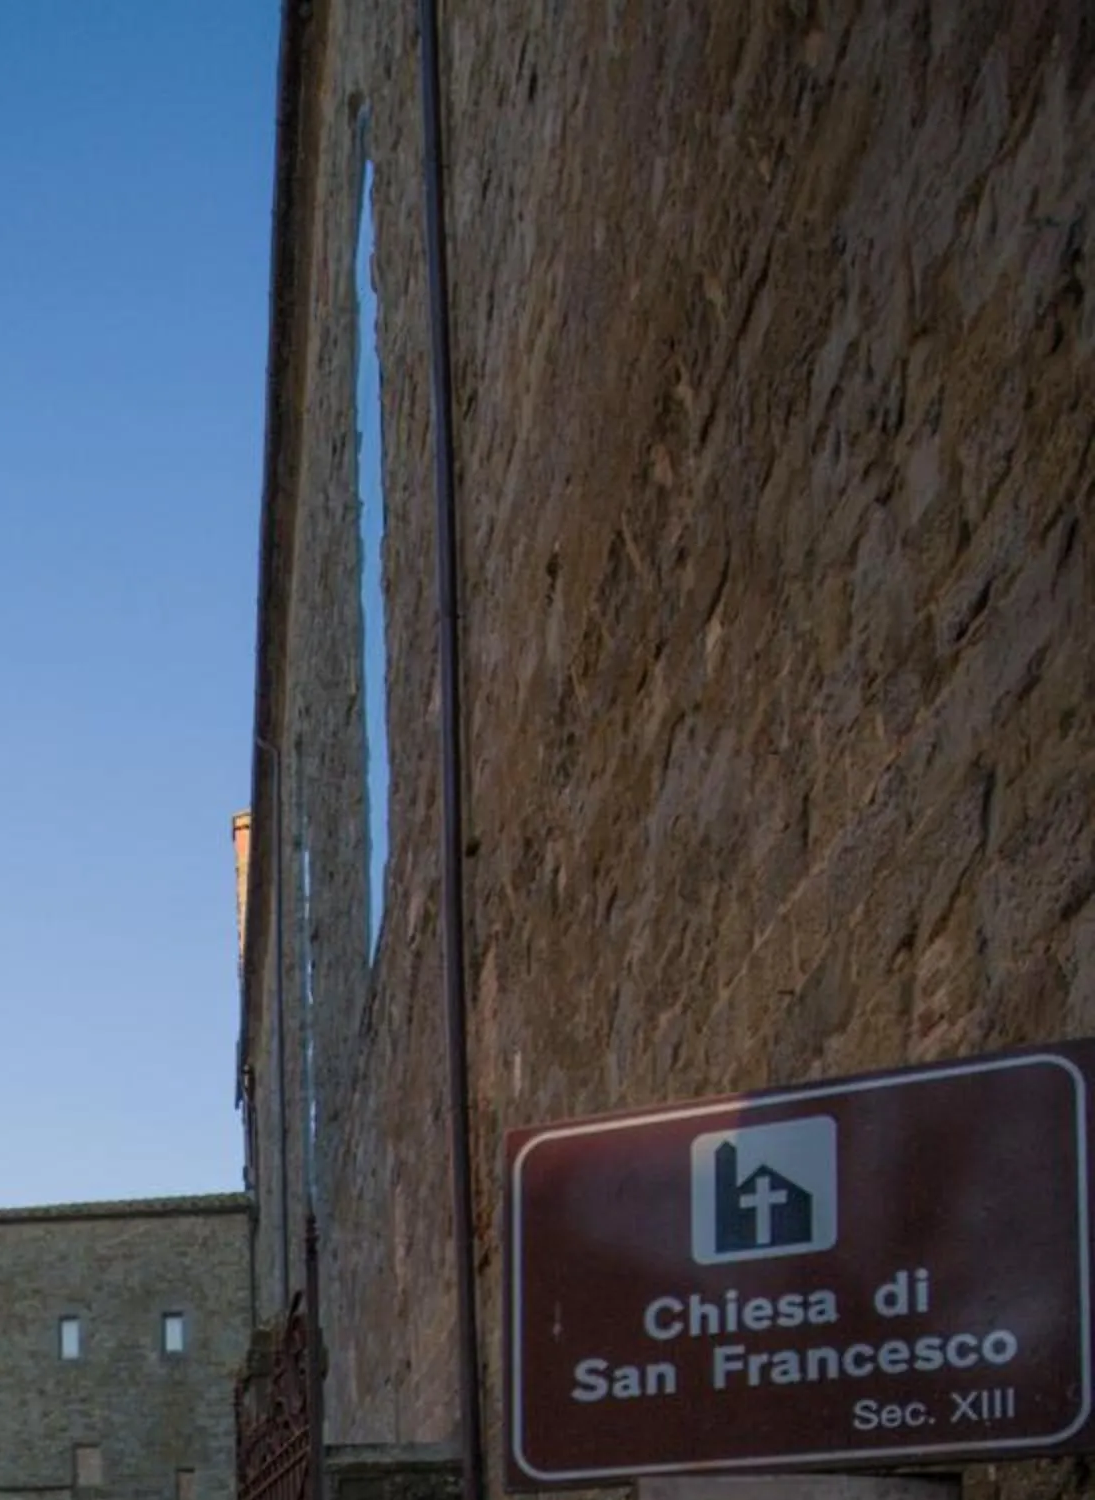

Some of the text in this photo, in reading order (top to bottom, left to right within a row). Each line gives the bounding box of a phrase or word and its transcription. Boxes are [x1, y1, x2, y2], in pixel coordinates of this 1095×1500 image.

[645, 1269, 929, 1340] Chiesa di
[572, 1329, 1018, 1401] San Francesco
[853, 1388, 1016, 1430] Sec. XIII
